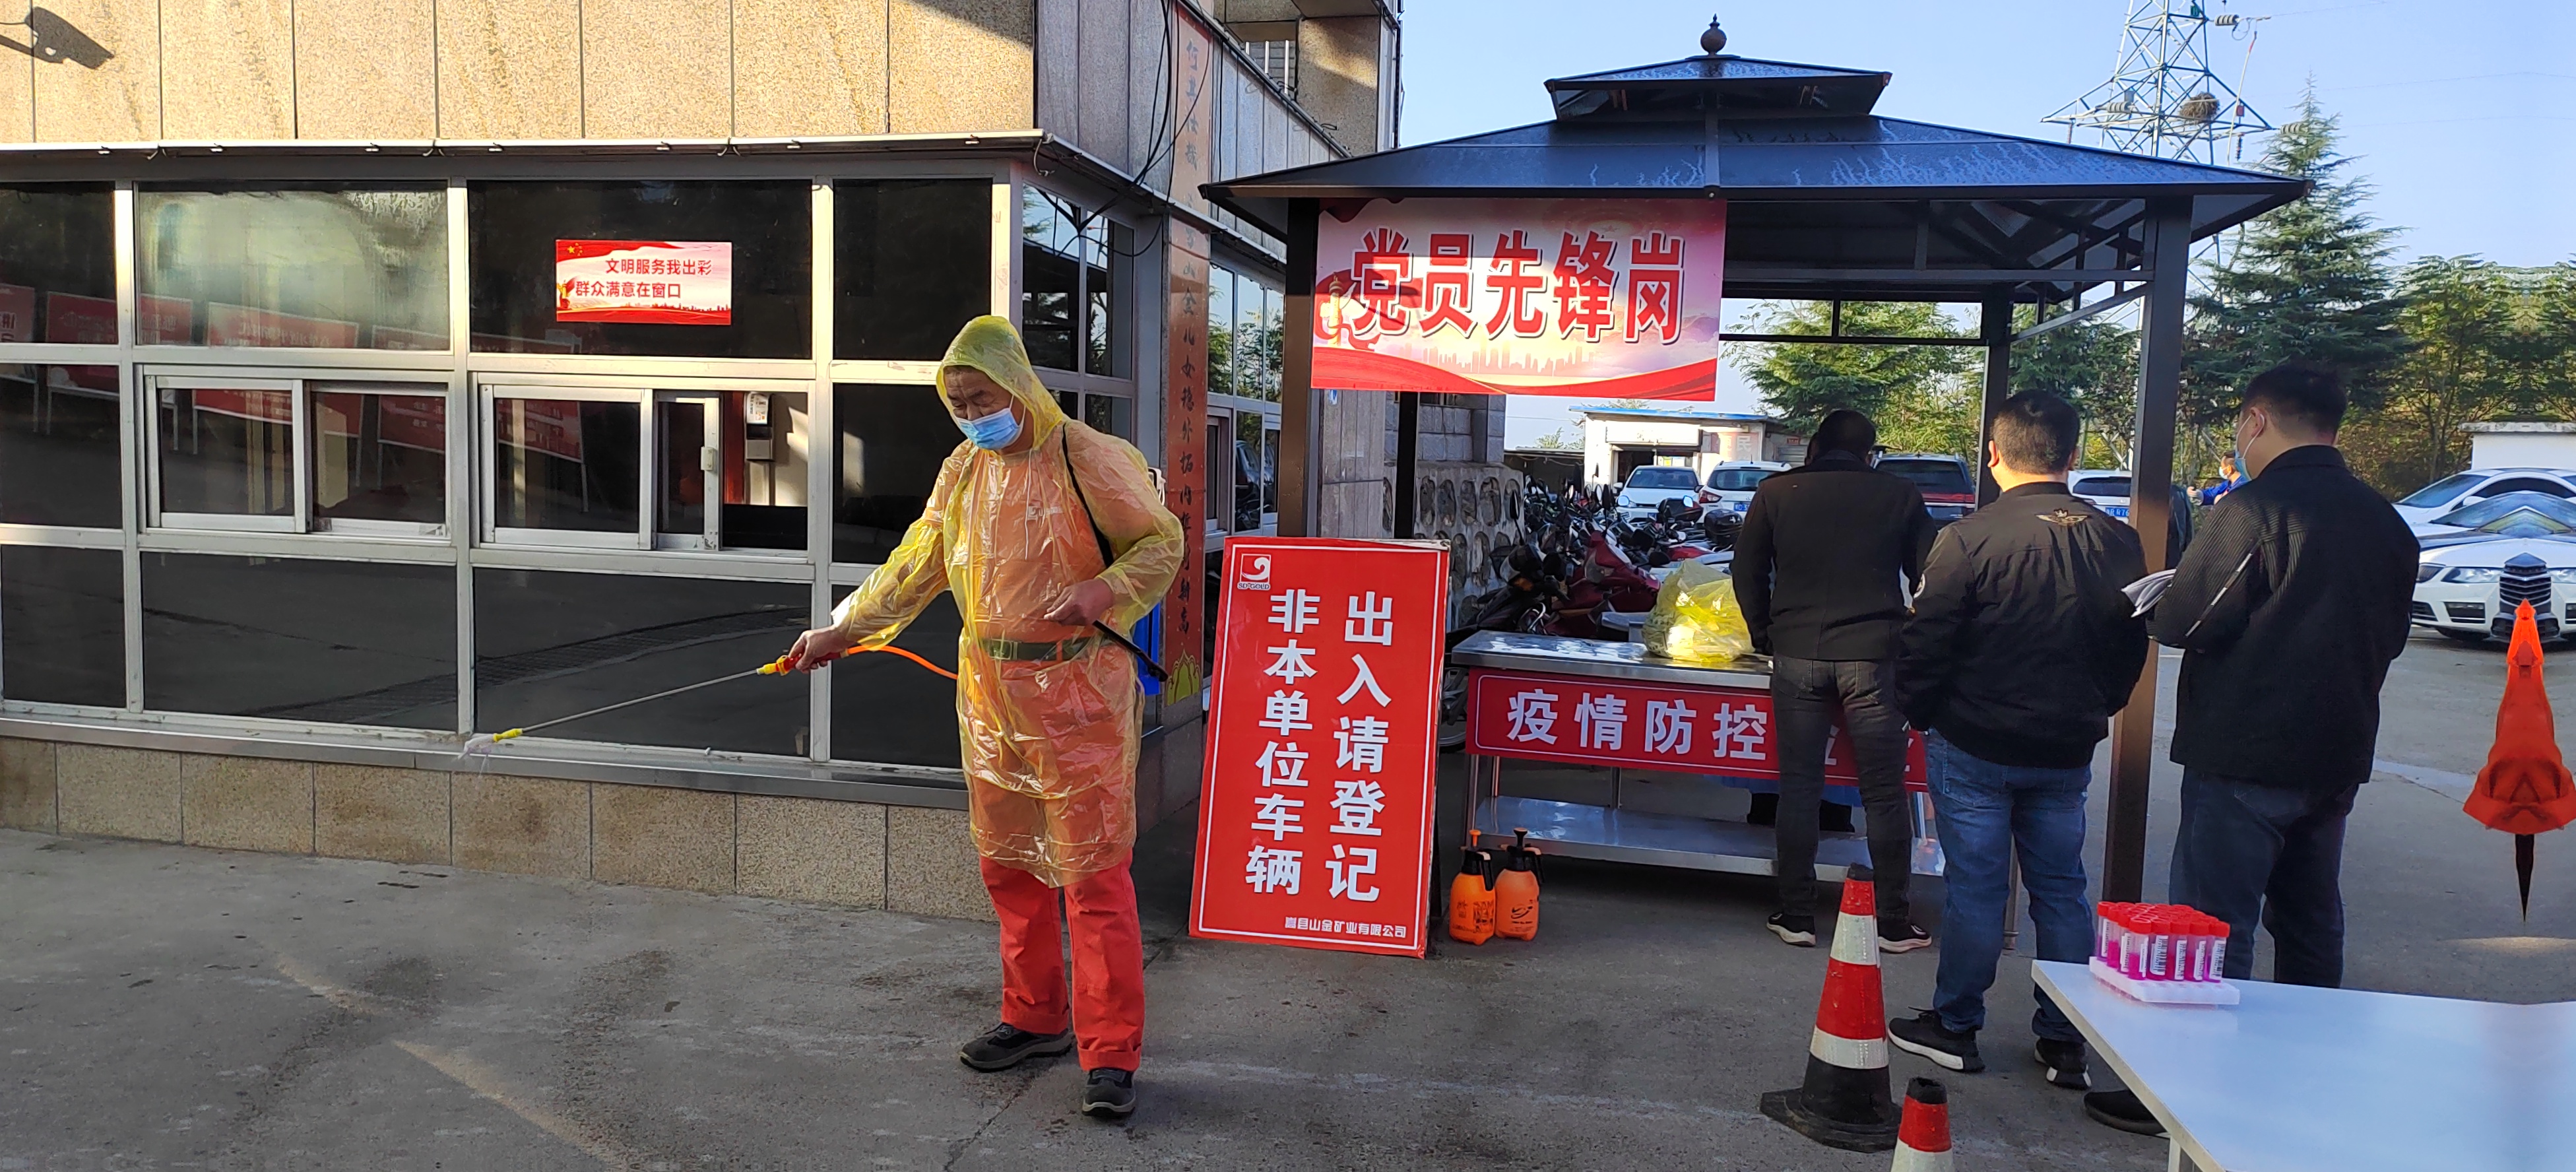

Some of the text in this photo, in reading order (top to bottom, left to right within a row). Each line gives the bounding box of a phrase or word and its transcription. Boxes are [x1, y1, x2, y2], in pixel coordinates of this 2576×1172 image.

[575, 281, 681, 298] 群众满意在窗口
[606, 259, 712, 275] 文明服务我出彩
[1351, 227, 1685, 342] 党员先锋岗
[1245, 589, 1320, 895] 非本单位车辆
[1325, 591, 1394, 902] 出入请登记
[1507, 688, 1914, 771] 疫情防控
